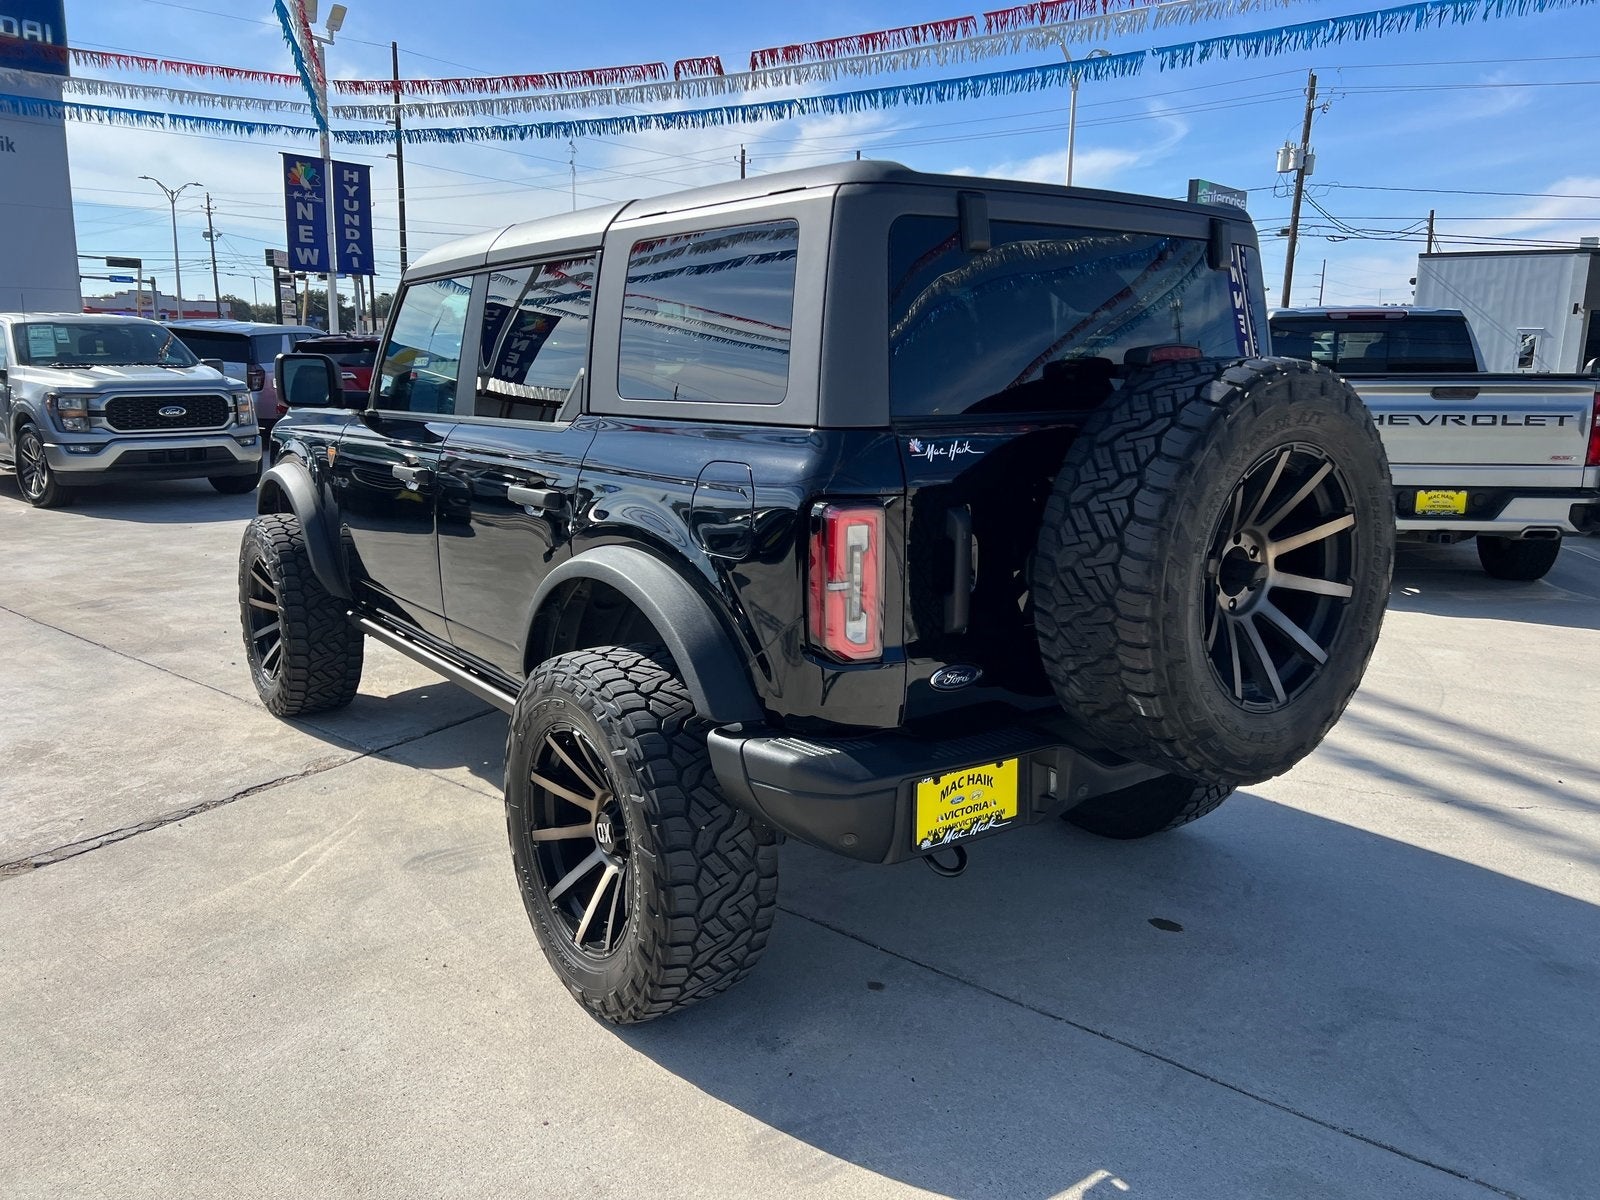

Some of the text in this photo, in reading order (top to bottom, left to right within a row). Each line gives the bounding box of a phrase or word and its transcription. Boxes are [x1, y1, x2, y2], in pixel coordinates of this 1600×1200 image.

[343, 169, 362, 268] HYUNDAI
[296, 202, 319, 265] NEW
[1373, 414, 1574, 426] HEVROLET
[912, 440, 984, 462] Mac Haik
[942, 672, 971, 685] Ford
[940, 776, 965, 802] MAC
[967, 773, 994, 788] HAIK
[944, 801, 989, 821] VICTORIA
[930, 817, 1011, 847] Mac Haik
